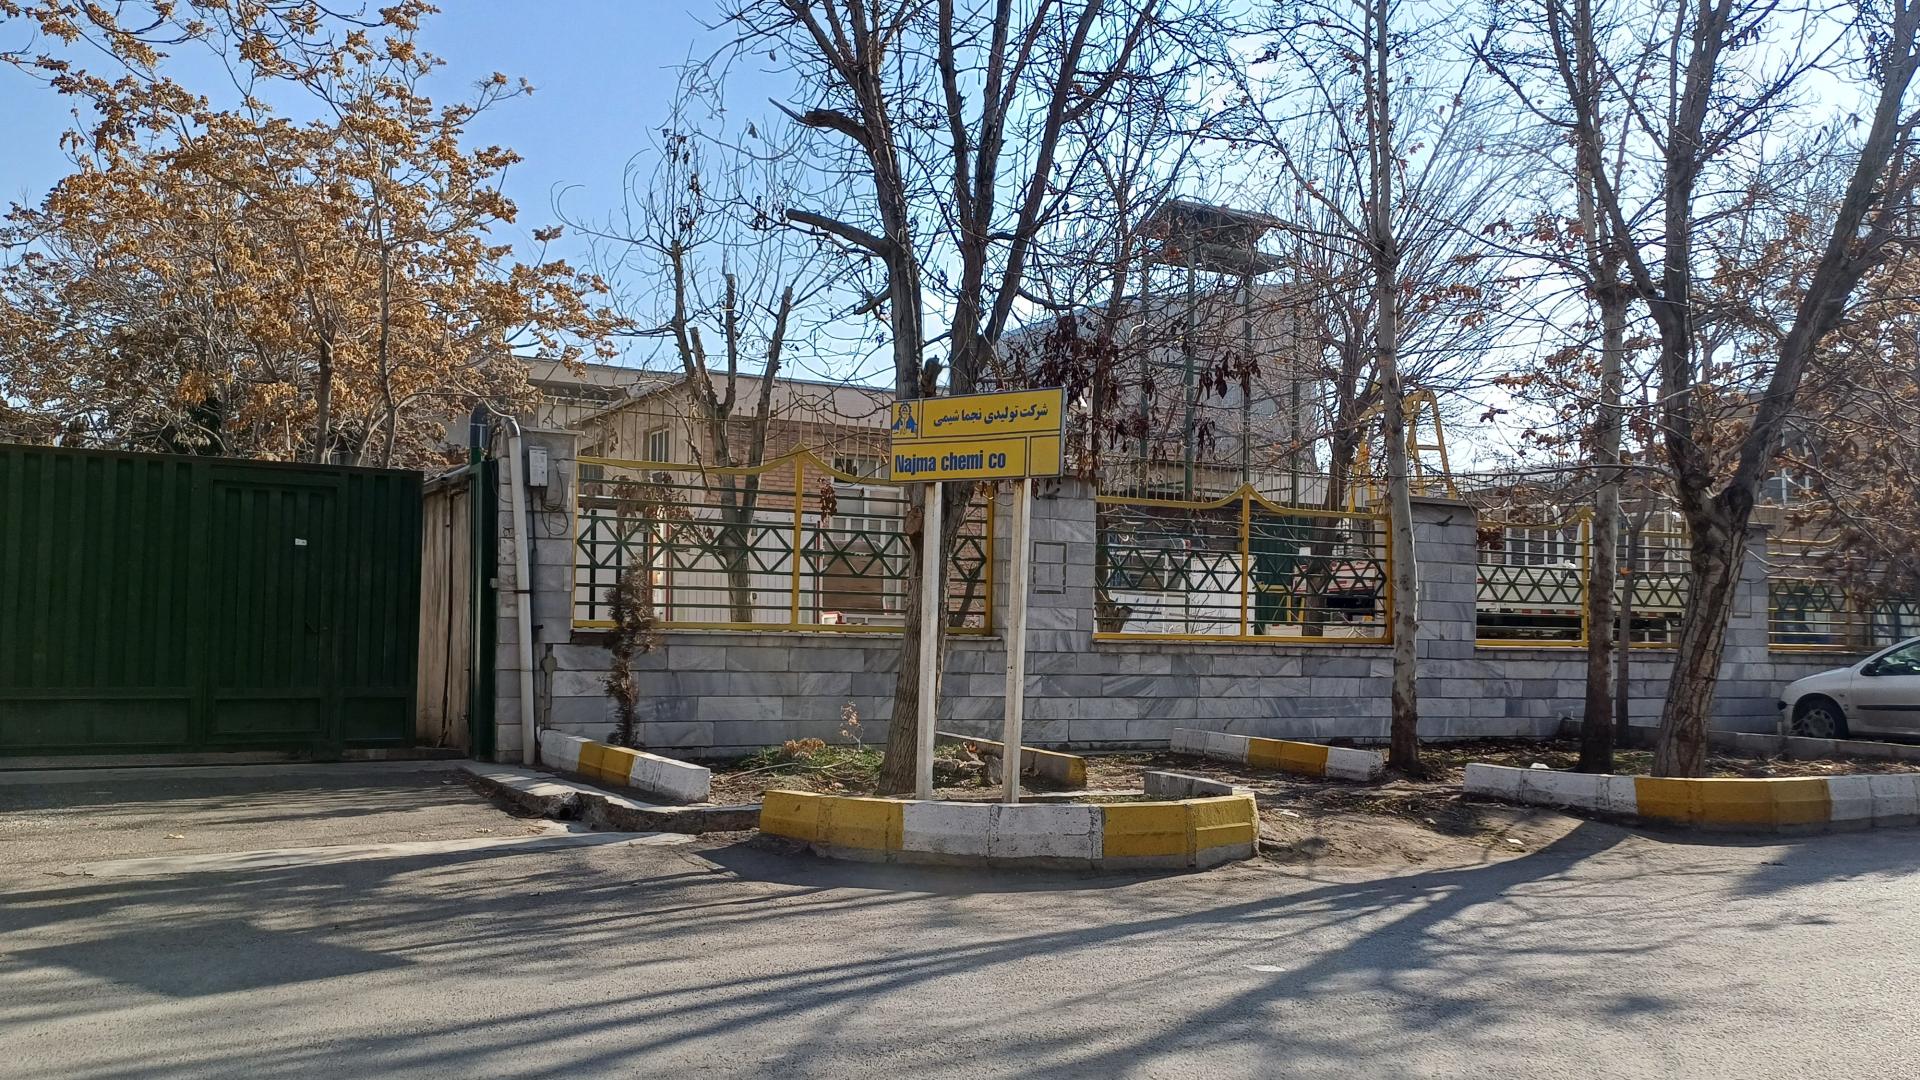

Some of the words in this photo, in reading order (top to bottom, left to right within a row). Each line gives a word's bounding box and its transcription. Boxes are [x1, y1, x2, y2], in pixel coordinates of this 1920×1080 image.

[933, 411, 960, 427] شیمی
[961, 408, 982, 424] نجما
[984, 405, 1019, 424] تولیدی
[1020, 403, 1049, 420] شرکت
[895, 454, 936, 475] Najma
[941, 450, 983, 471] chemi
[988, 452, 1006, 469] co
